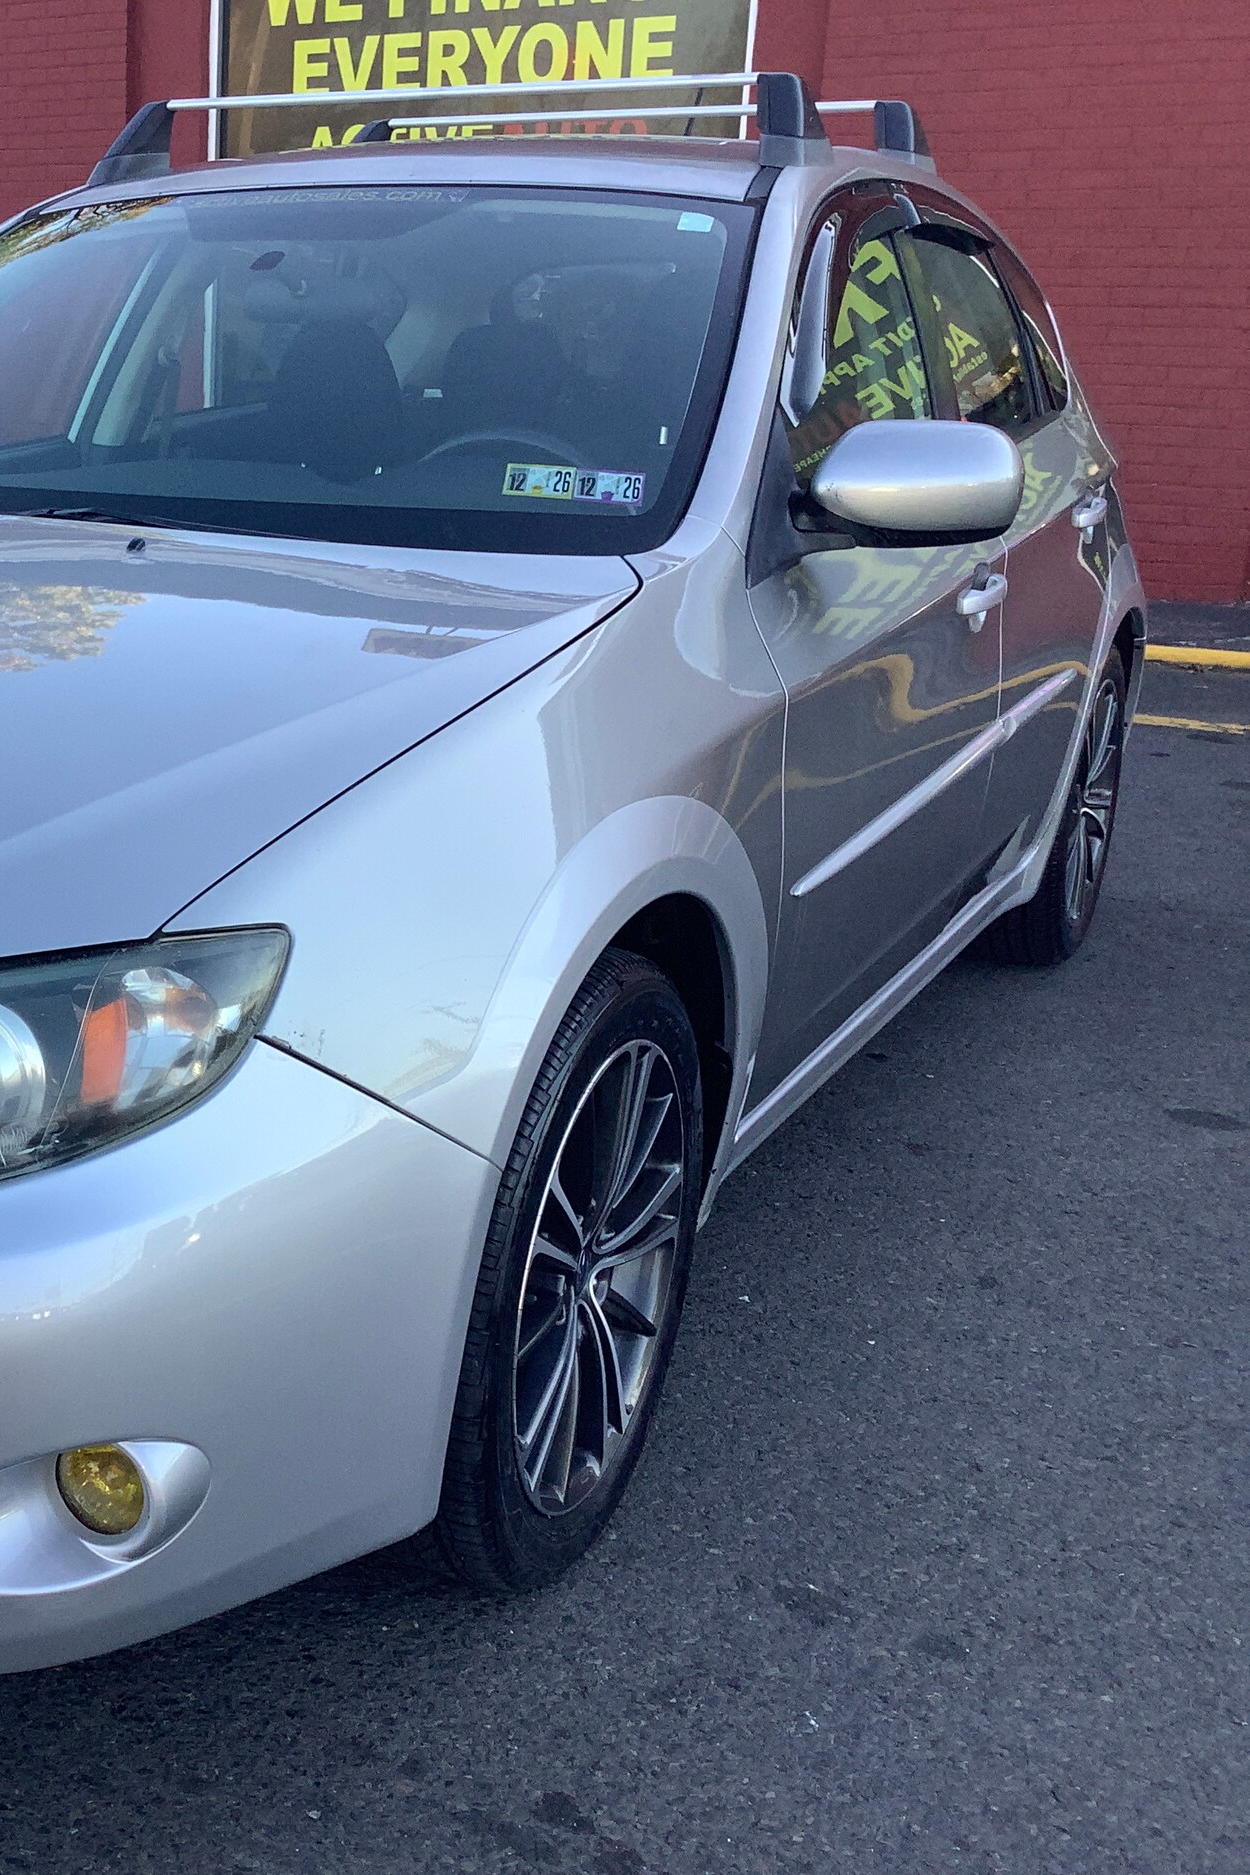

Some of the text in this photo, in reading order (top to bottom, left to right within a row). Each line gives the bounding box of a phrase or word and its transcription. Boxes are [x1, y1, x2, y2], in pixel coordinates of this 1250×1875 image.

[293, 15, 677, 94] EVERYONE
[508, 471, 572, 493] 12 26
[578, 477, 641, 500] 12 26
